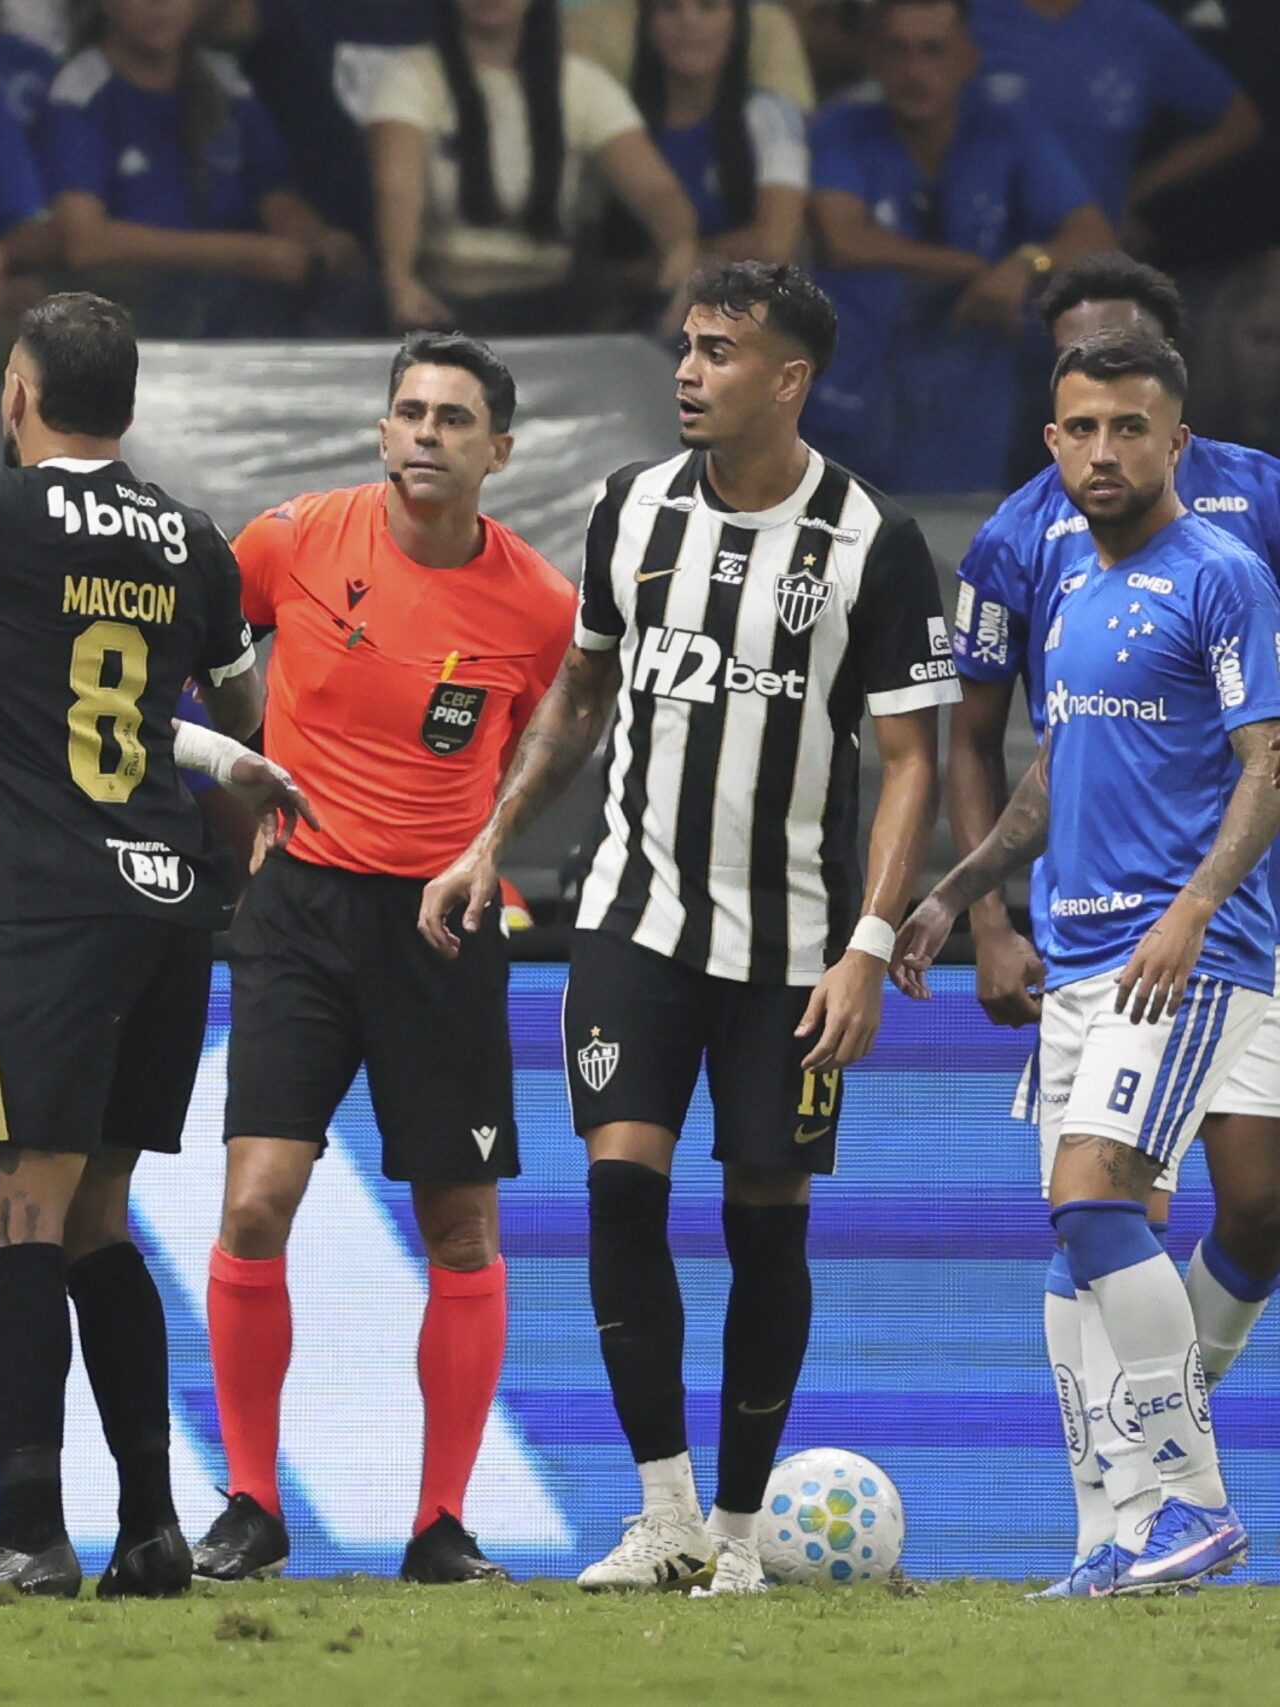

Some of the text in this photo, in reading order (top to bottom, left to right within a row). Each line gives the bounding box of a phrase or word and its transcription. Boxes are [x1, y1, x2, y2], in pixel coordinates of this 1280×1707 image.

[83, 490, 189, 565] bmg
[62, 575, 176, 625] MAYCON
[1127, 573, 1174, 596] CIMED
[440, 690, 478, 709] CBF
[1220, 658, 1246, 708] OMO
[67, 620, 149, 803] 8
[128, 851, 181, 892] BH
[1106, 1066, 1142, 1115] 8
[1056, 1373, 1083, 1454] Kodilar
[1137, 1392, 1184, 1418] CEC
